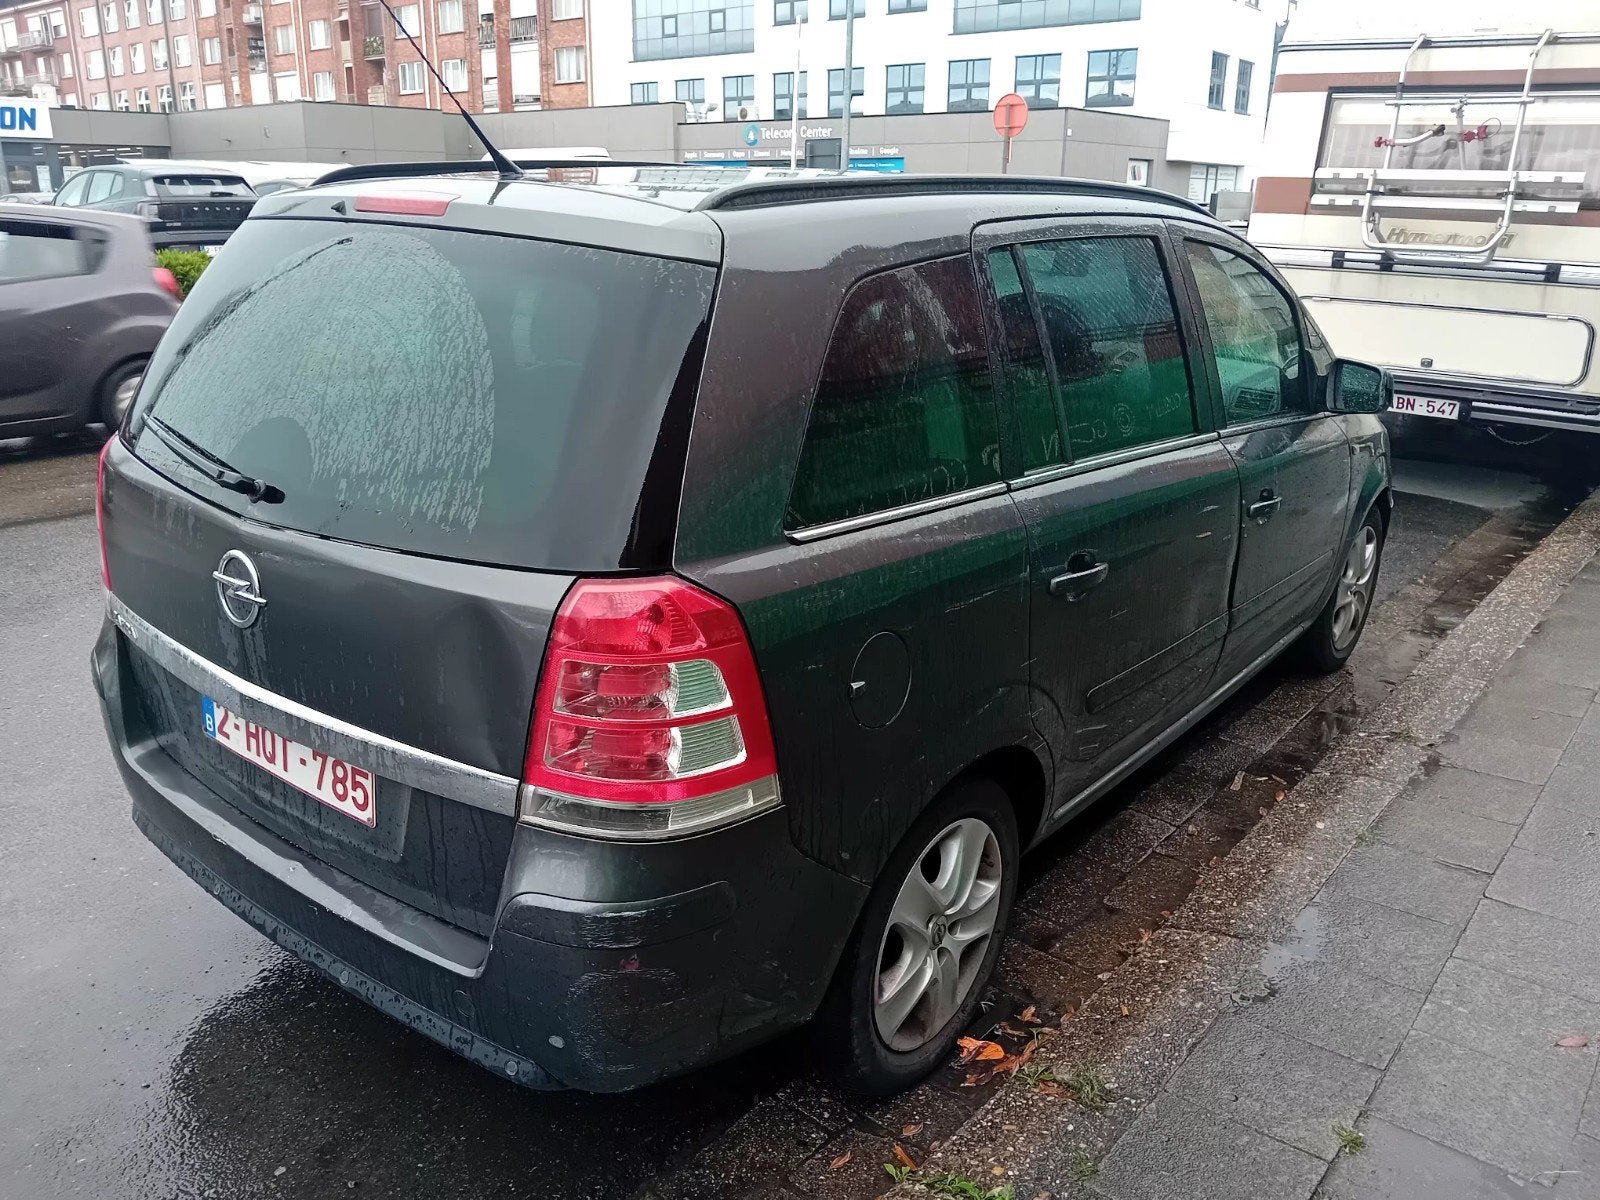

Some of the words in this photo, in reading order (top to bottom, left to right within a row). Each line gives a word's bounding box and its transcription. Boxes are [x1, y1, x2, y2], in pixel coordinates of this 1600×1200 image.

[761, 127, 797, 139] Teleco
[800, 126, 832, 138] Center
[879, 146, 899, 156] Google
[206, 713, 214, 732] B
